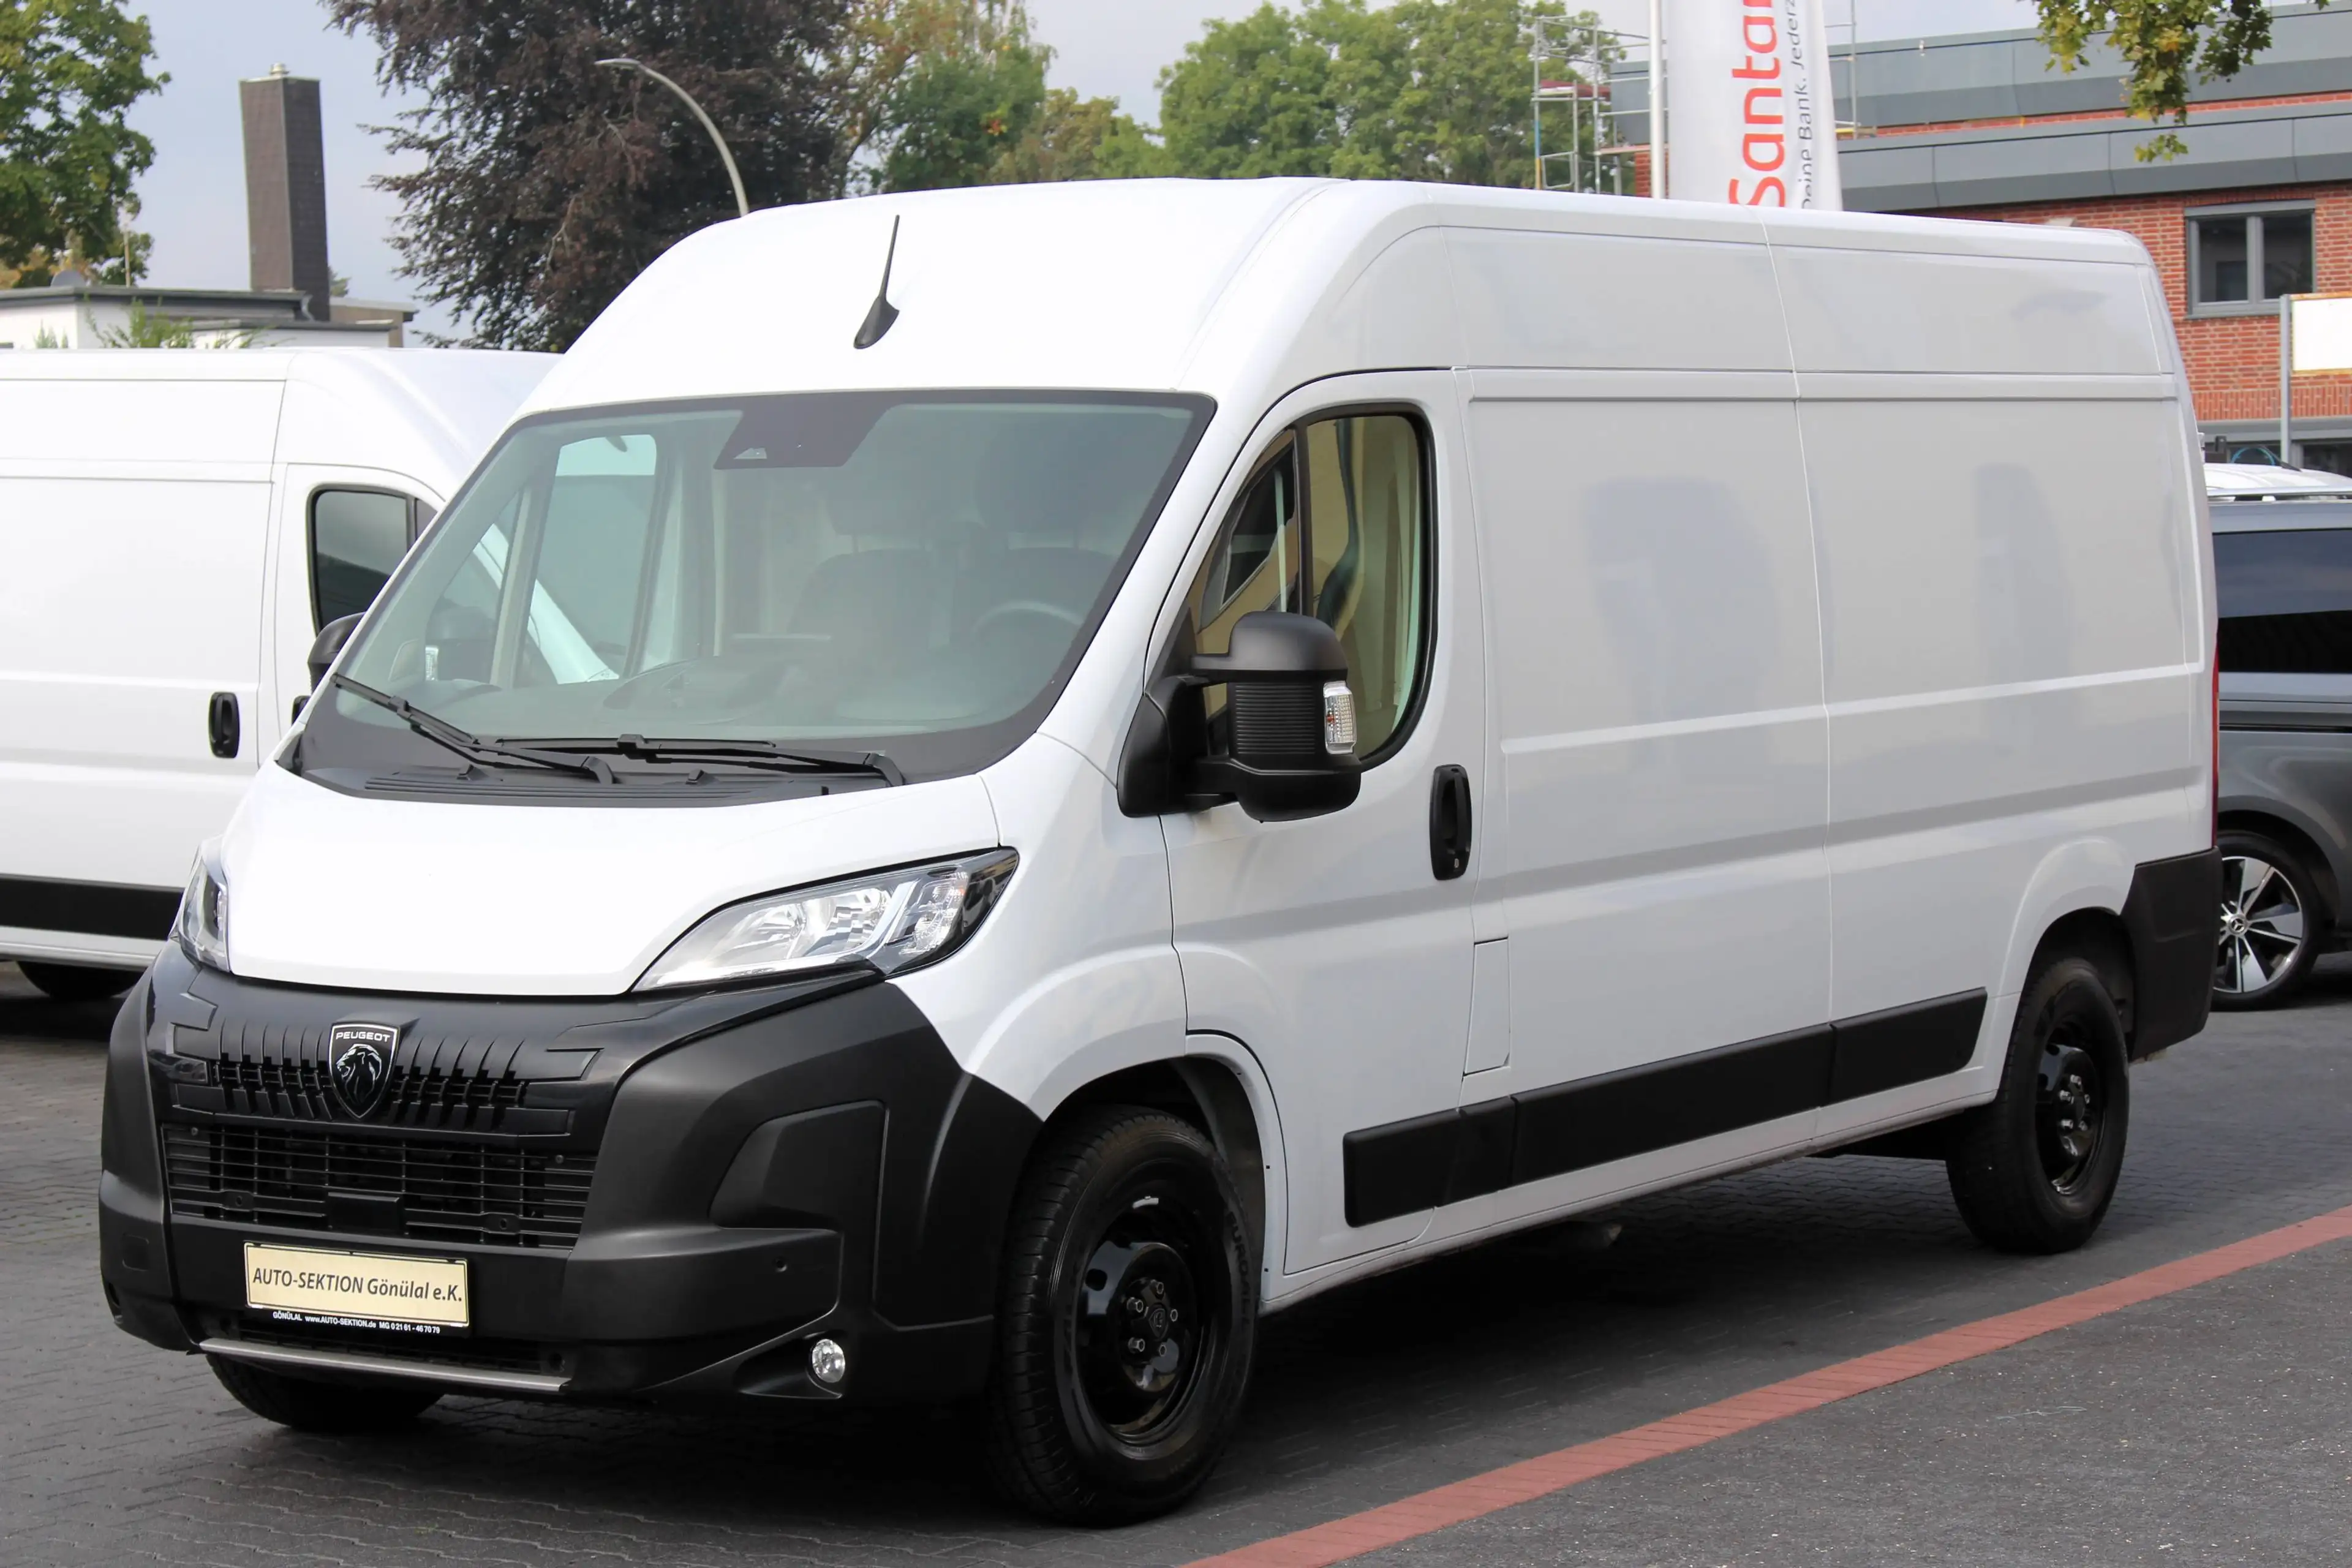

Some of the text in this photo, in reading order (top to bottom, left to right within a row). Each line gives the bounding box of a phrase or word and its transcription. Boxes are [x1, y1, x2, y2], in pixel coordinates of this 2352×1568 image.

[1728, 0, 1785, 207] Santa
[1793, 78, 1813, 140] Bank.
[336, 1031, 391, 1042] PEUGEOT
[252, 1267, 462, 1302] AUTO-SEKTION Gönülal e.K.
[273, 1310, 303, 1321] GÖNÜLAL
[305, 1316, 377, 1328] www.AUTO-SEKTION.de
